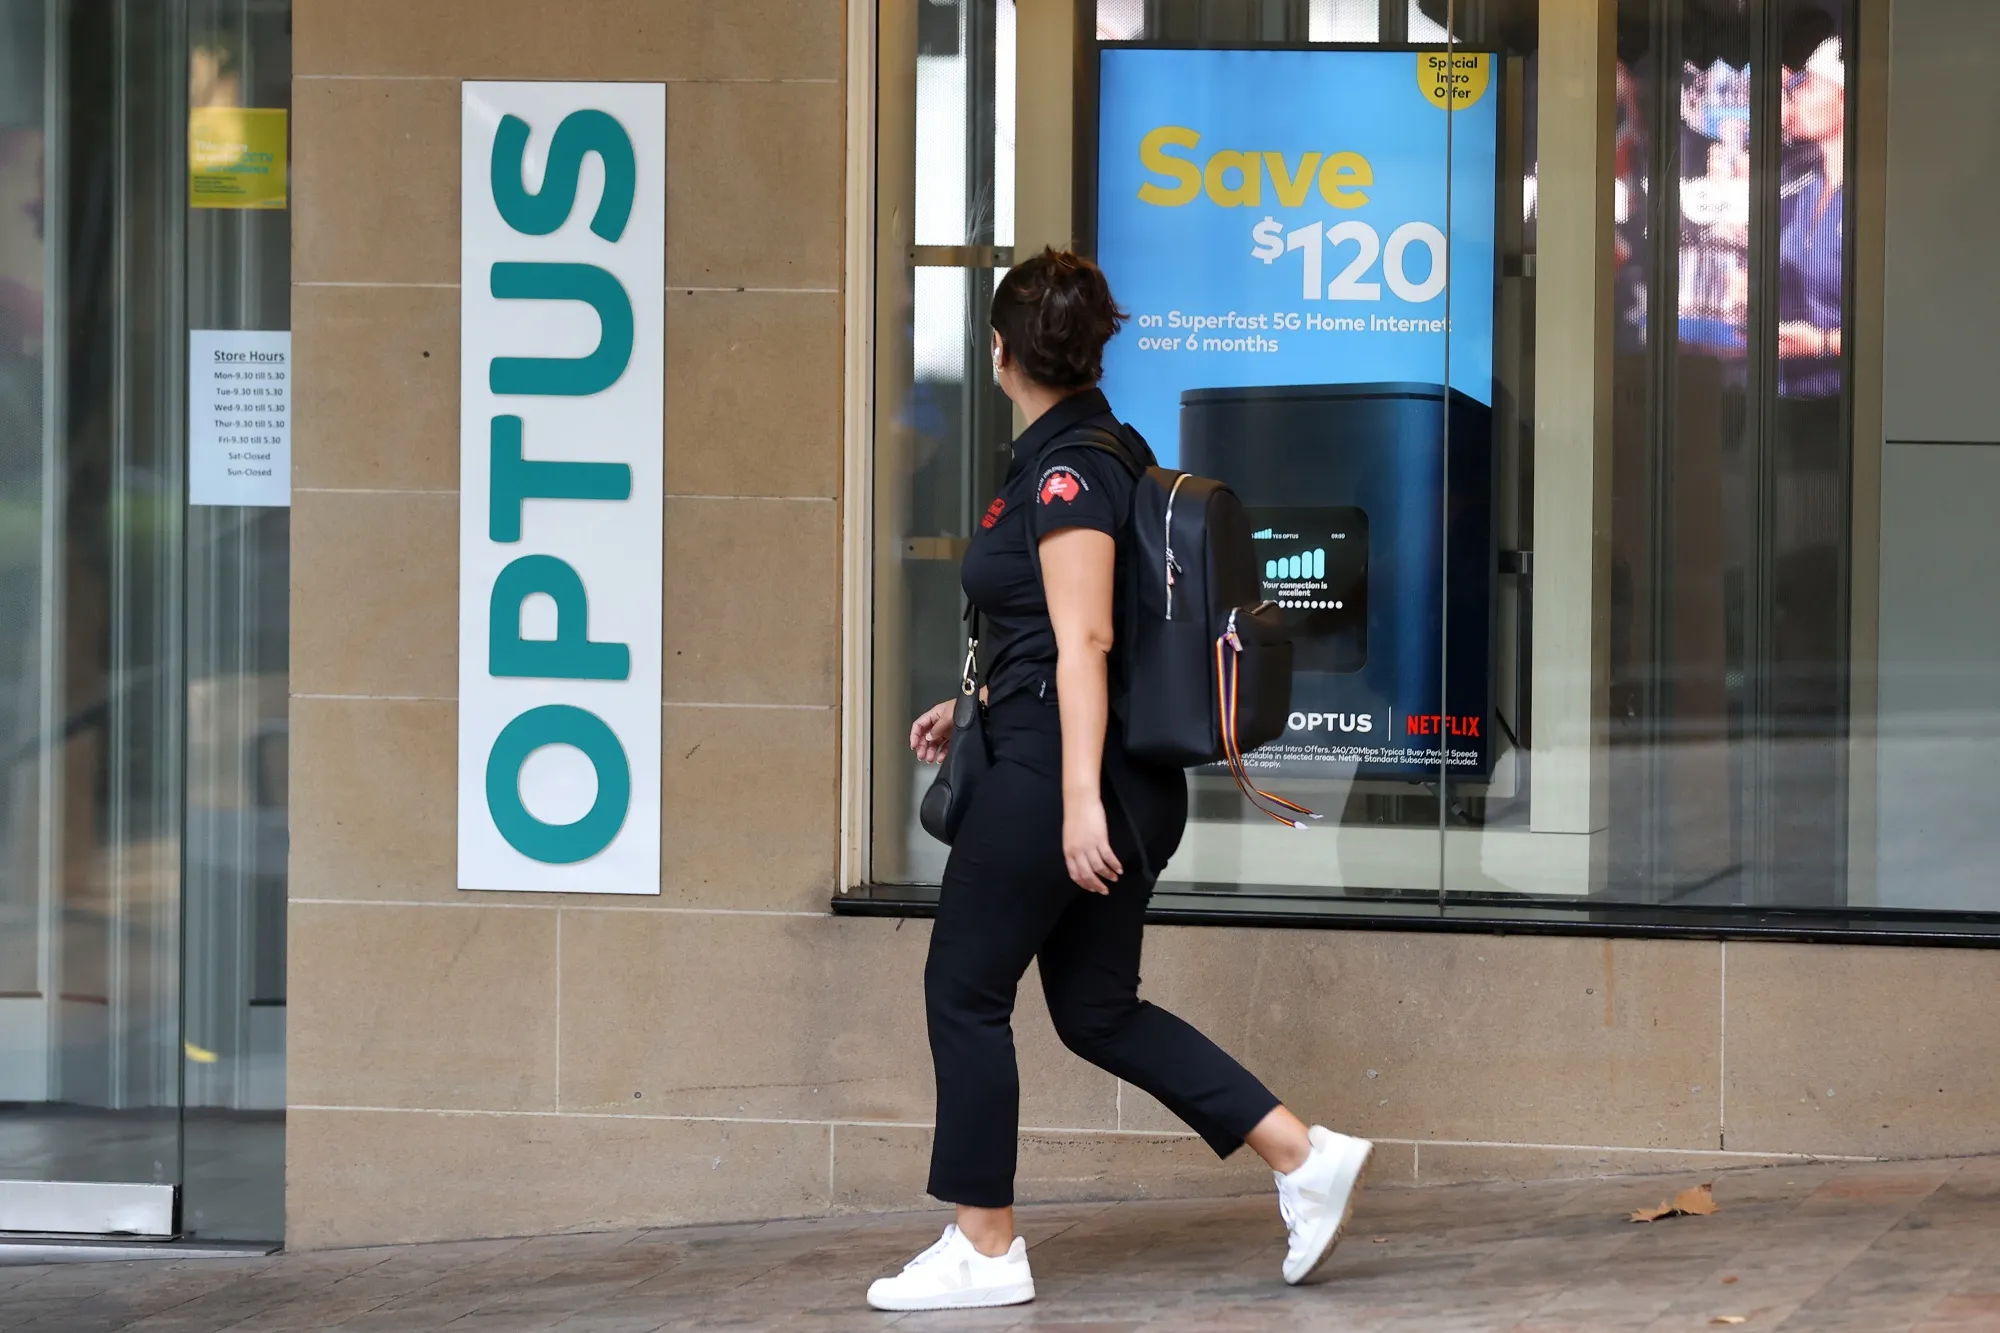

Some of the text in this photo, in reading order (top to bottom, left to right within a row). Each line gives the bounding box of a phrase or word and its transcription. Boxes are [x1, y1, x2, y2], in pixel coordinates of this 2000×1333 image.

[1434, 86, 1471, 98] Ofer
[1136, 125, 1374, 209] Save
[1250, 215, 1448, 303] $120
[1138, 313, 1163, 328] on
[1167, 309, 1268, 332] Superfast
[1272, 312, 1302, 331] 5G
[1305, 312, 1366, 331] Home
[1137, 333, 1279, 352] over 6 months
[214, 350, 285, 362] Store Hours
[214, 372, 285, 380] Mon-9.30 till 5.30
[265, 388, 283, 396] 5.30
[267, 404, 285, 412] 5.30
[214, 420, 285, 428] Thur-9.30 till 5.30
[263, 436, 281, 444] 5.30
[228, 452, 271, 460] Sat-Closed
[227, 468, 272, 476] Sun-Closed
[486, 108, 636, 864] OPTUS
[1262, 581, 1328, 590] Your connection is
[1278, 589, 1311, 597] excellent
[1287, 711, 1373, 733] OPTUS
[1285, 744, 1303, 752] Intro
[1304, 745, 1330, 754] Offers.
[1332, 746, 1379, 756] 240/20Mbps
[1380, 747, 1405, 756] Typical
[1406, 748, 1424, 758] Busy
[1451, 750, 1478, 758] Speeds
[1338, 754, 1362, 762] Netflix
[1364, 754, 1399, 763] Standard
[1260, 760, 1282, 769] apply.
